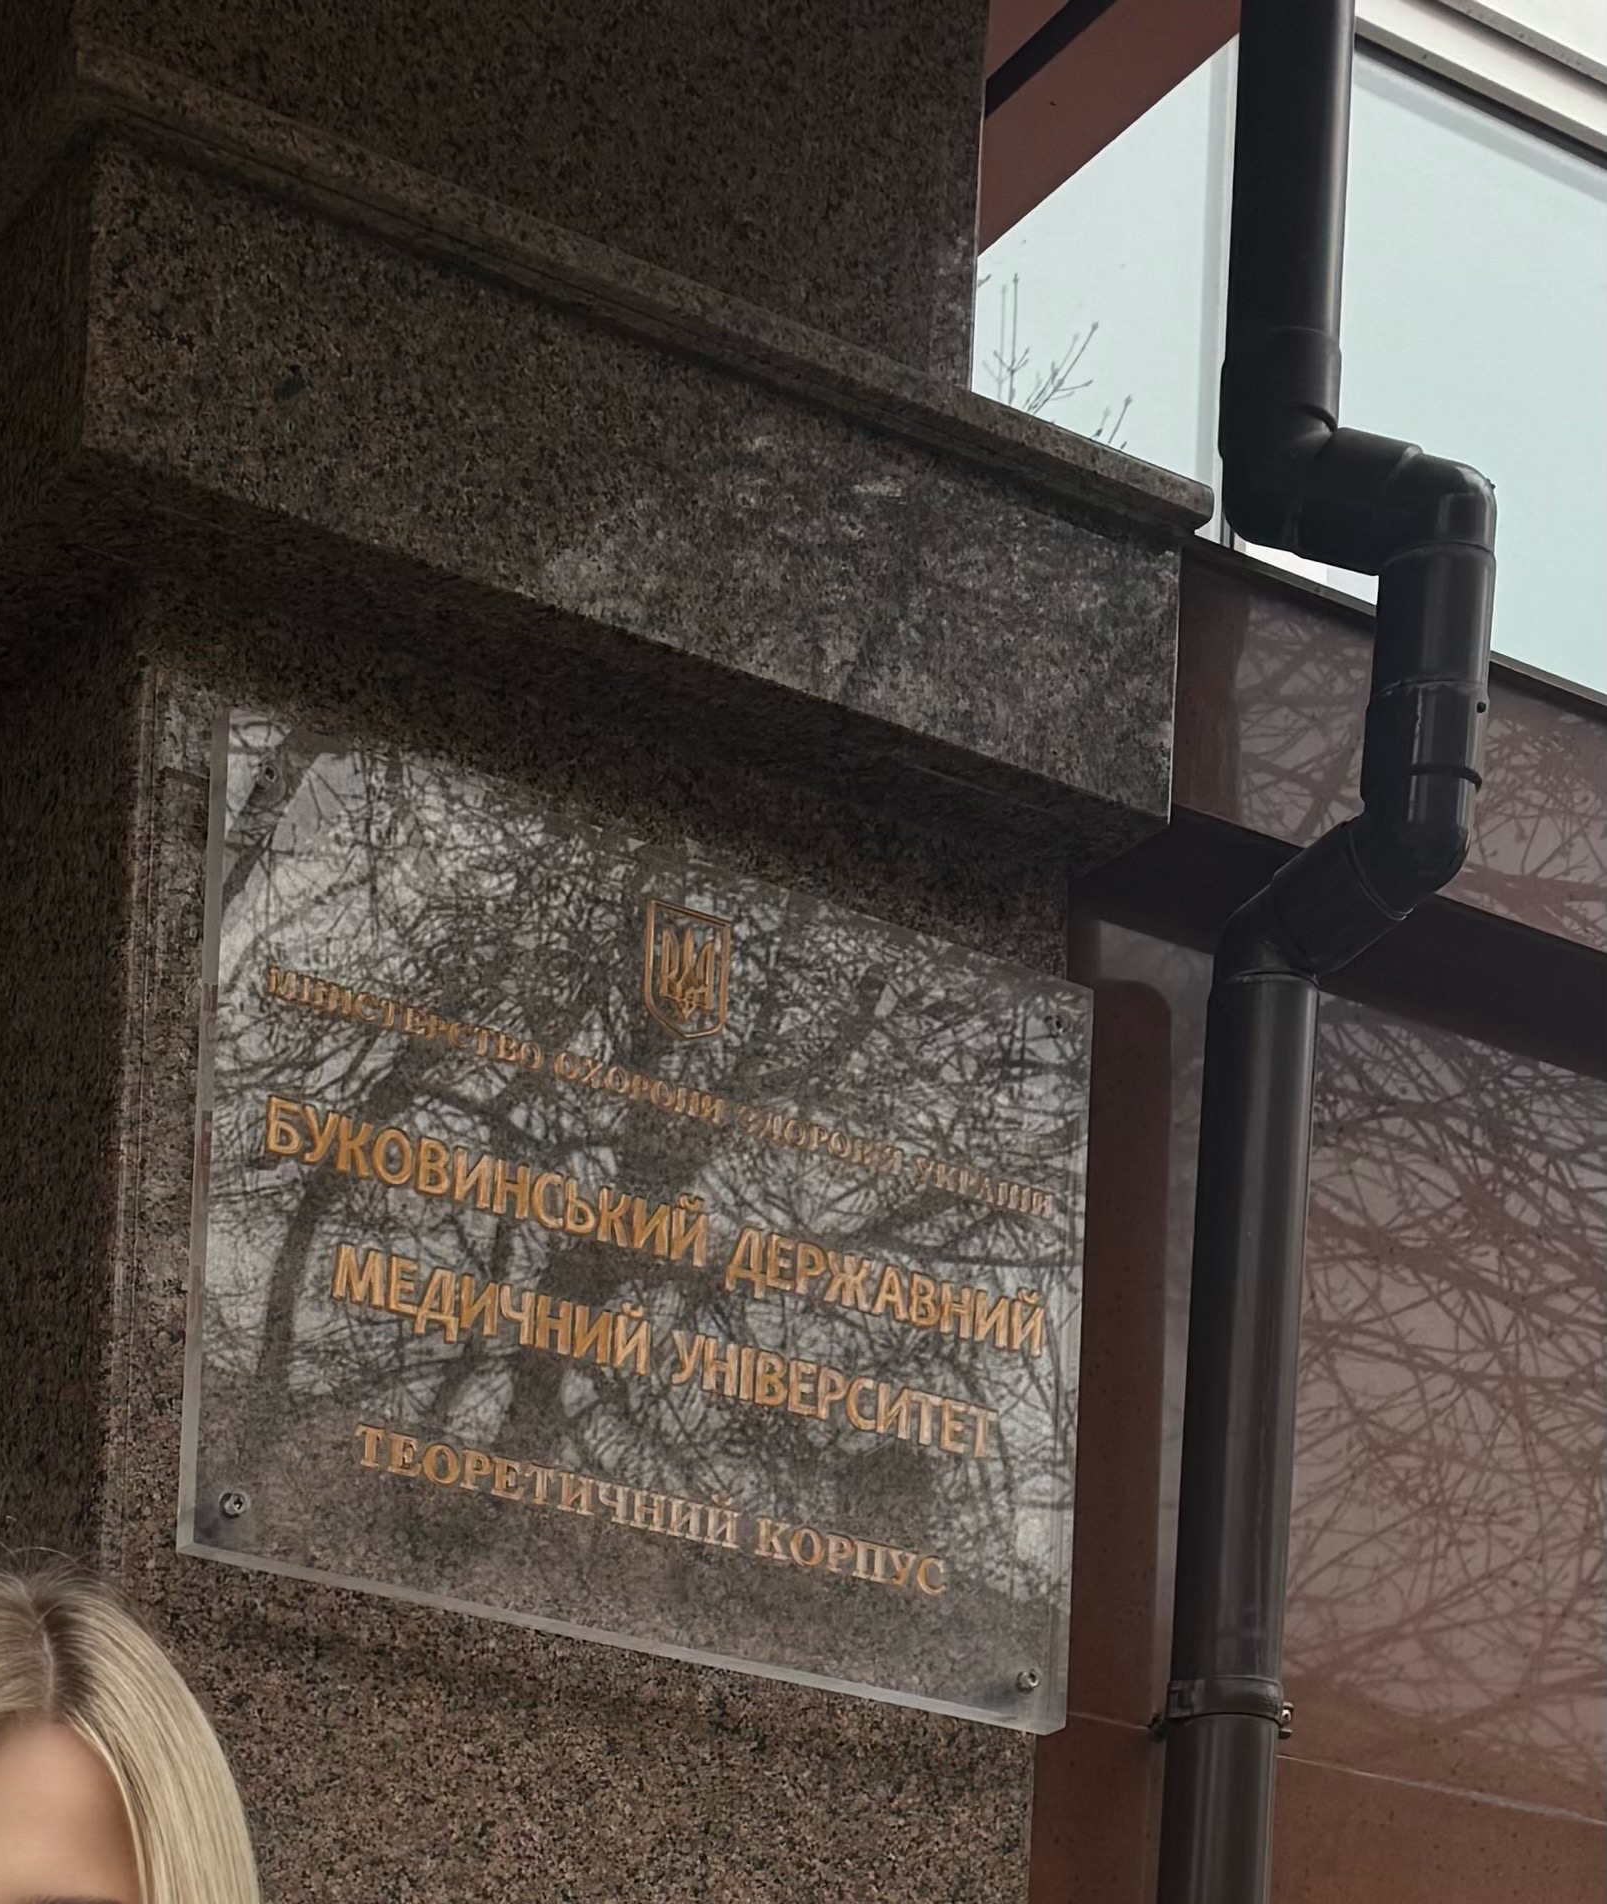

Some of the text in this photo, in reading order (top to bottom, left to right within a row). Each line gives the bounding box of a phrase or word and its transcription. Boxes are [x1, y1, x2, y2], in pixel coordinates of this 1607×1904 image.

[267, 964, 544, 1071] МІНІСТЕРСТВО
[554, 1051, 725, 1124] ОХОРОНИ
[265, 1095, 1046, 1358] БУКОВИНСЬКИЙ ДЕРЖАВНИЙ
[331, 1243, 1000, 1459] МЕДИЧНИЙ УНІВЕРСИТЕТ
[355, 1423, 949, 1596] ТЕОРЕТИЧНИЙ КОРПУС
